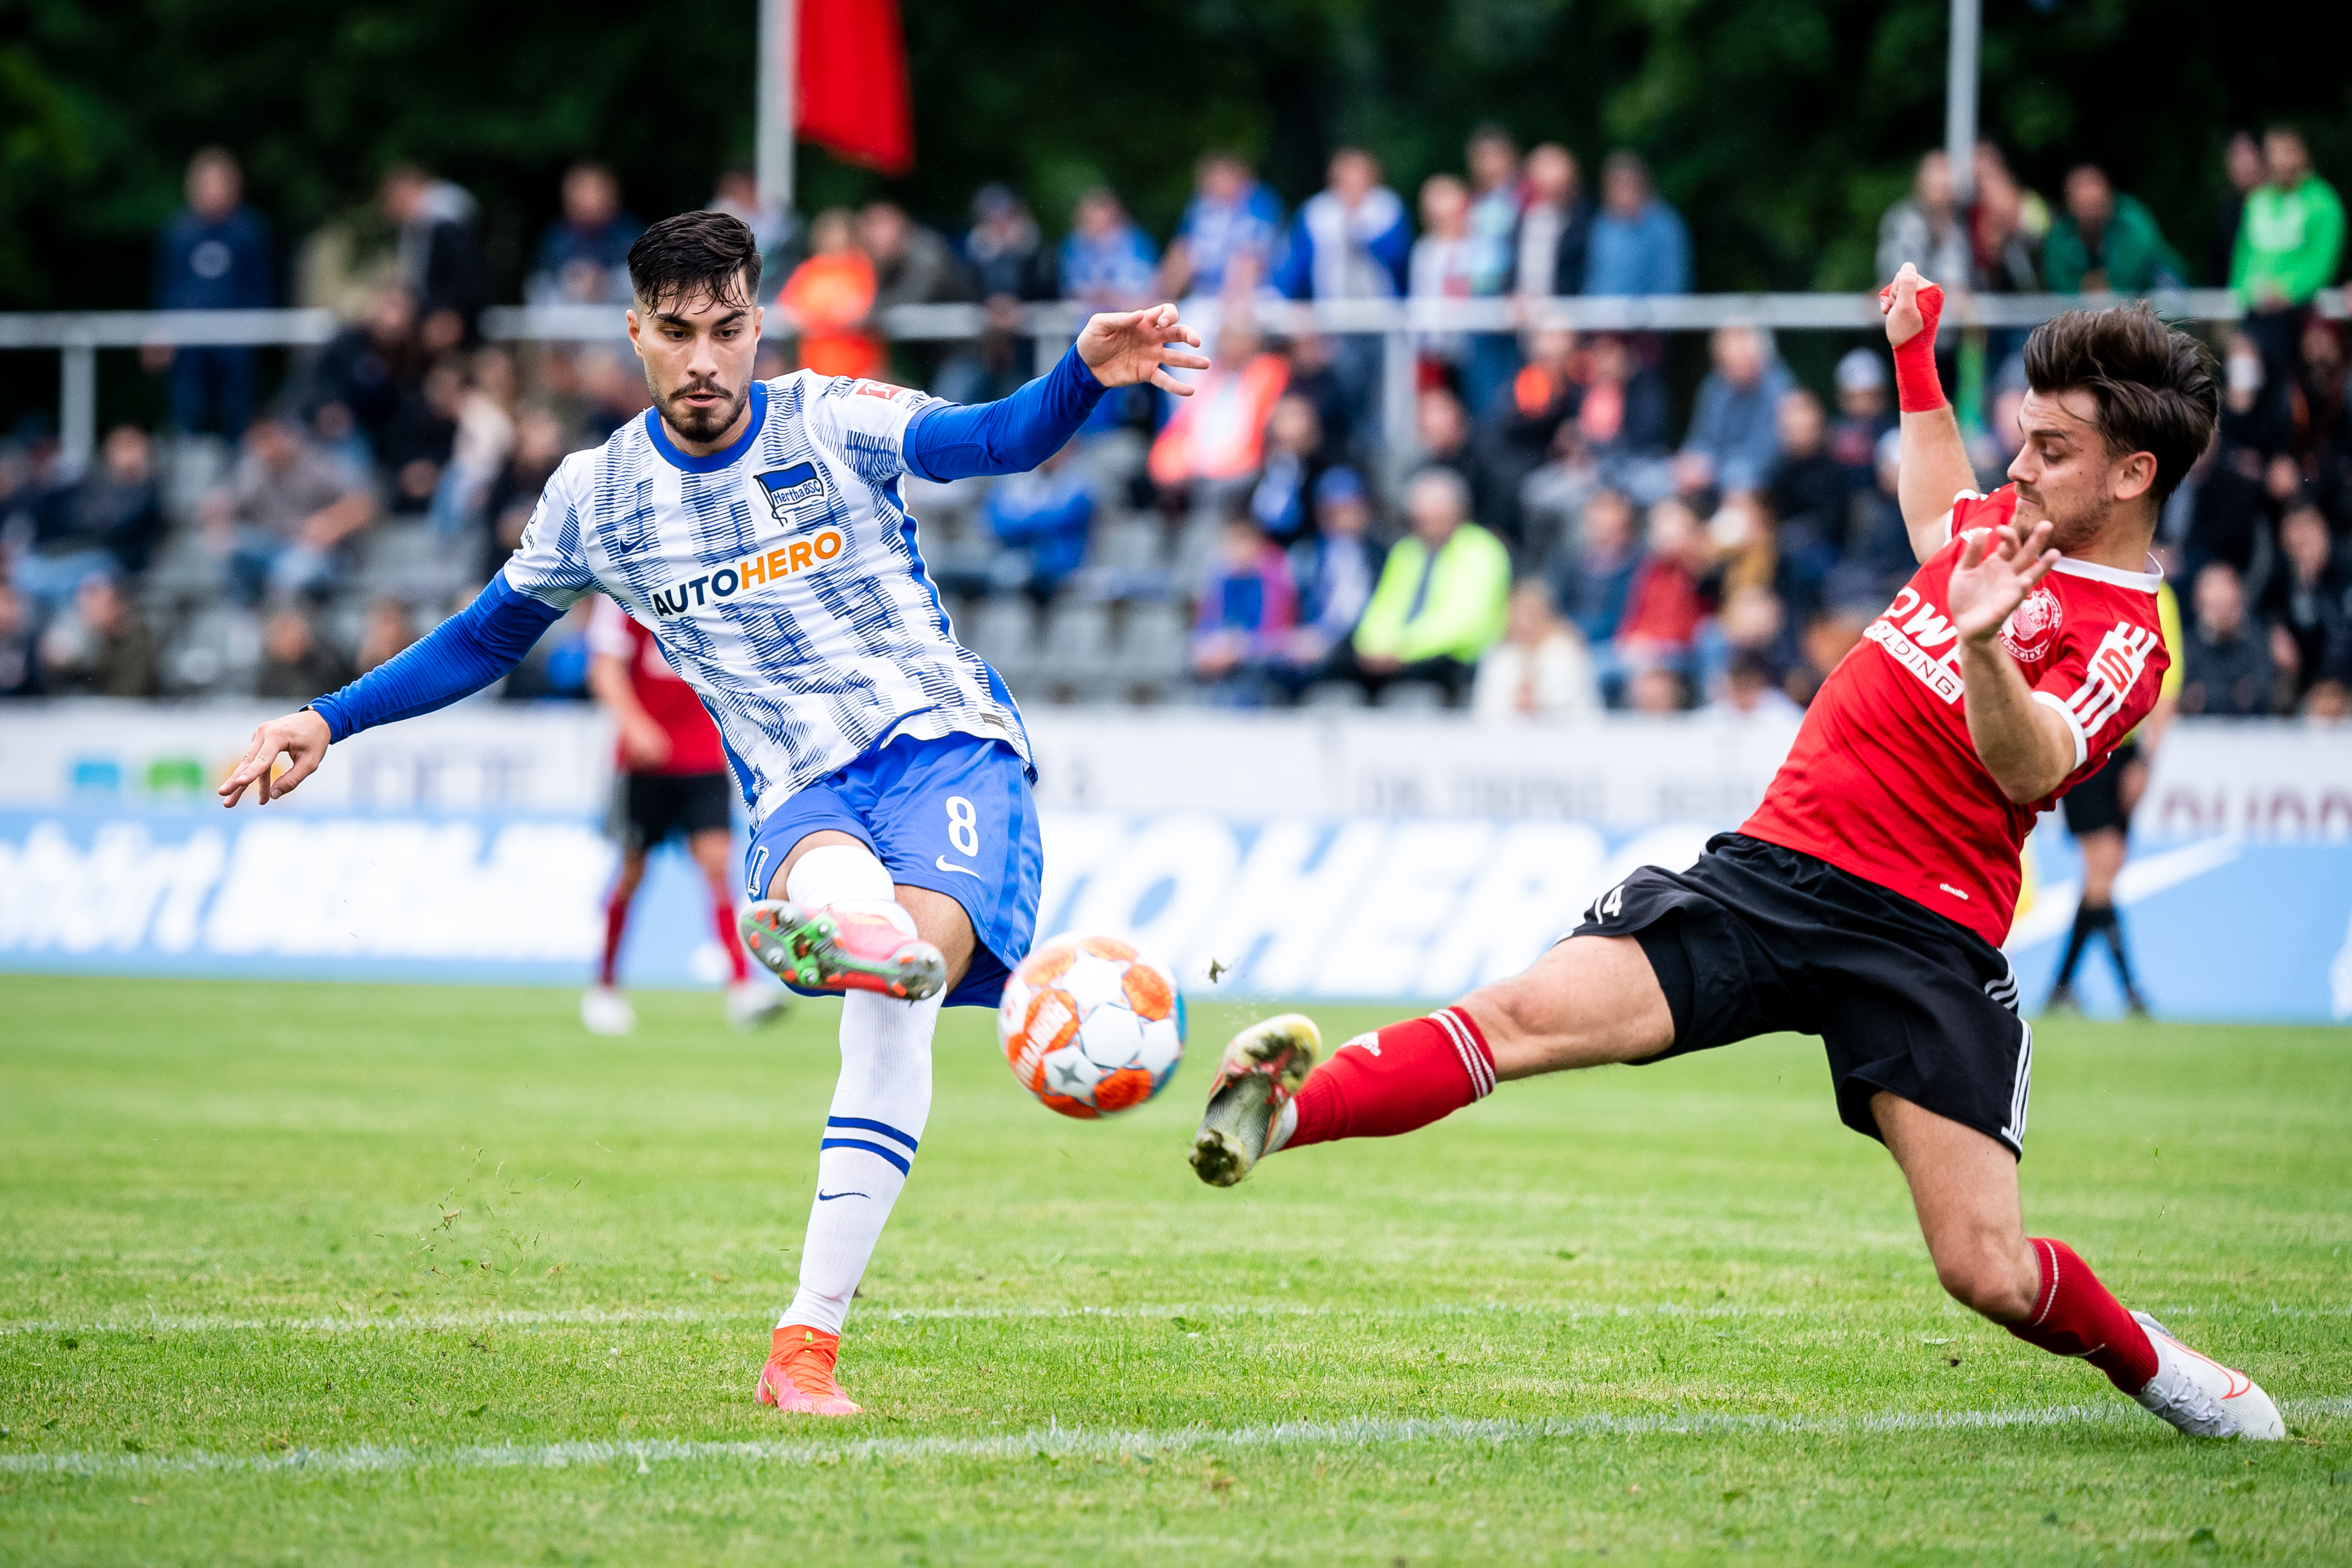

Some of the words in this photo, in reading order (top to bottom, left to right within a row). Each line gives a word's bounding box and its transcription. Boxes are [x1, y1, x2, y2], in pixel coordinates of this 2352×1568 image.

[773, 488, 805, 504] Hertha
[802, 480, 820, 496] BSC
[652, 531, 841, 616] AUTOHERO
[945, 795, 979, 857] 8
